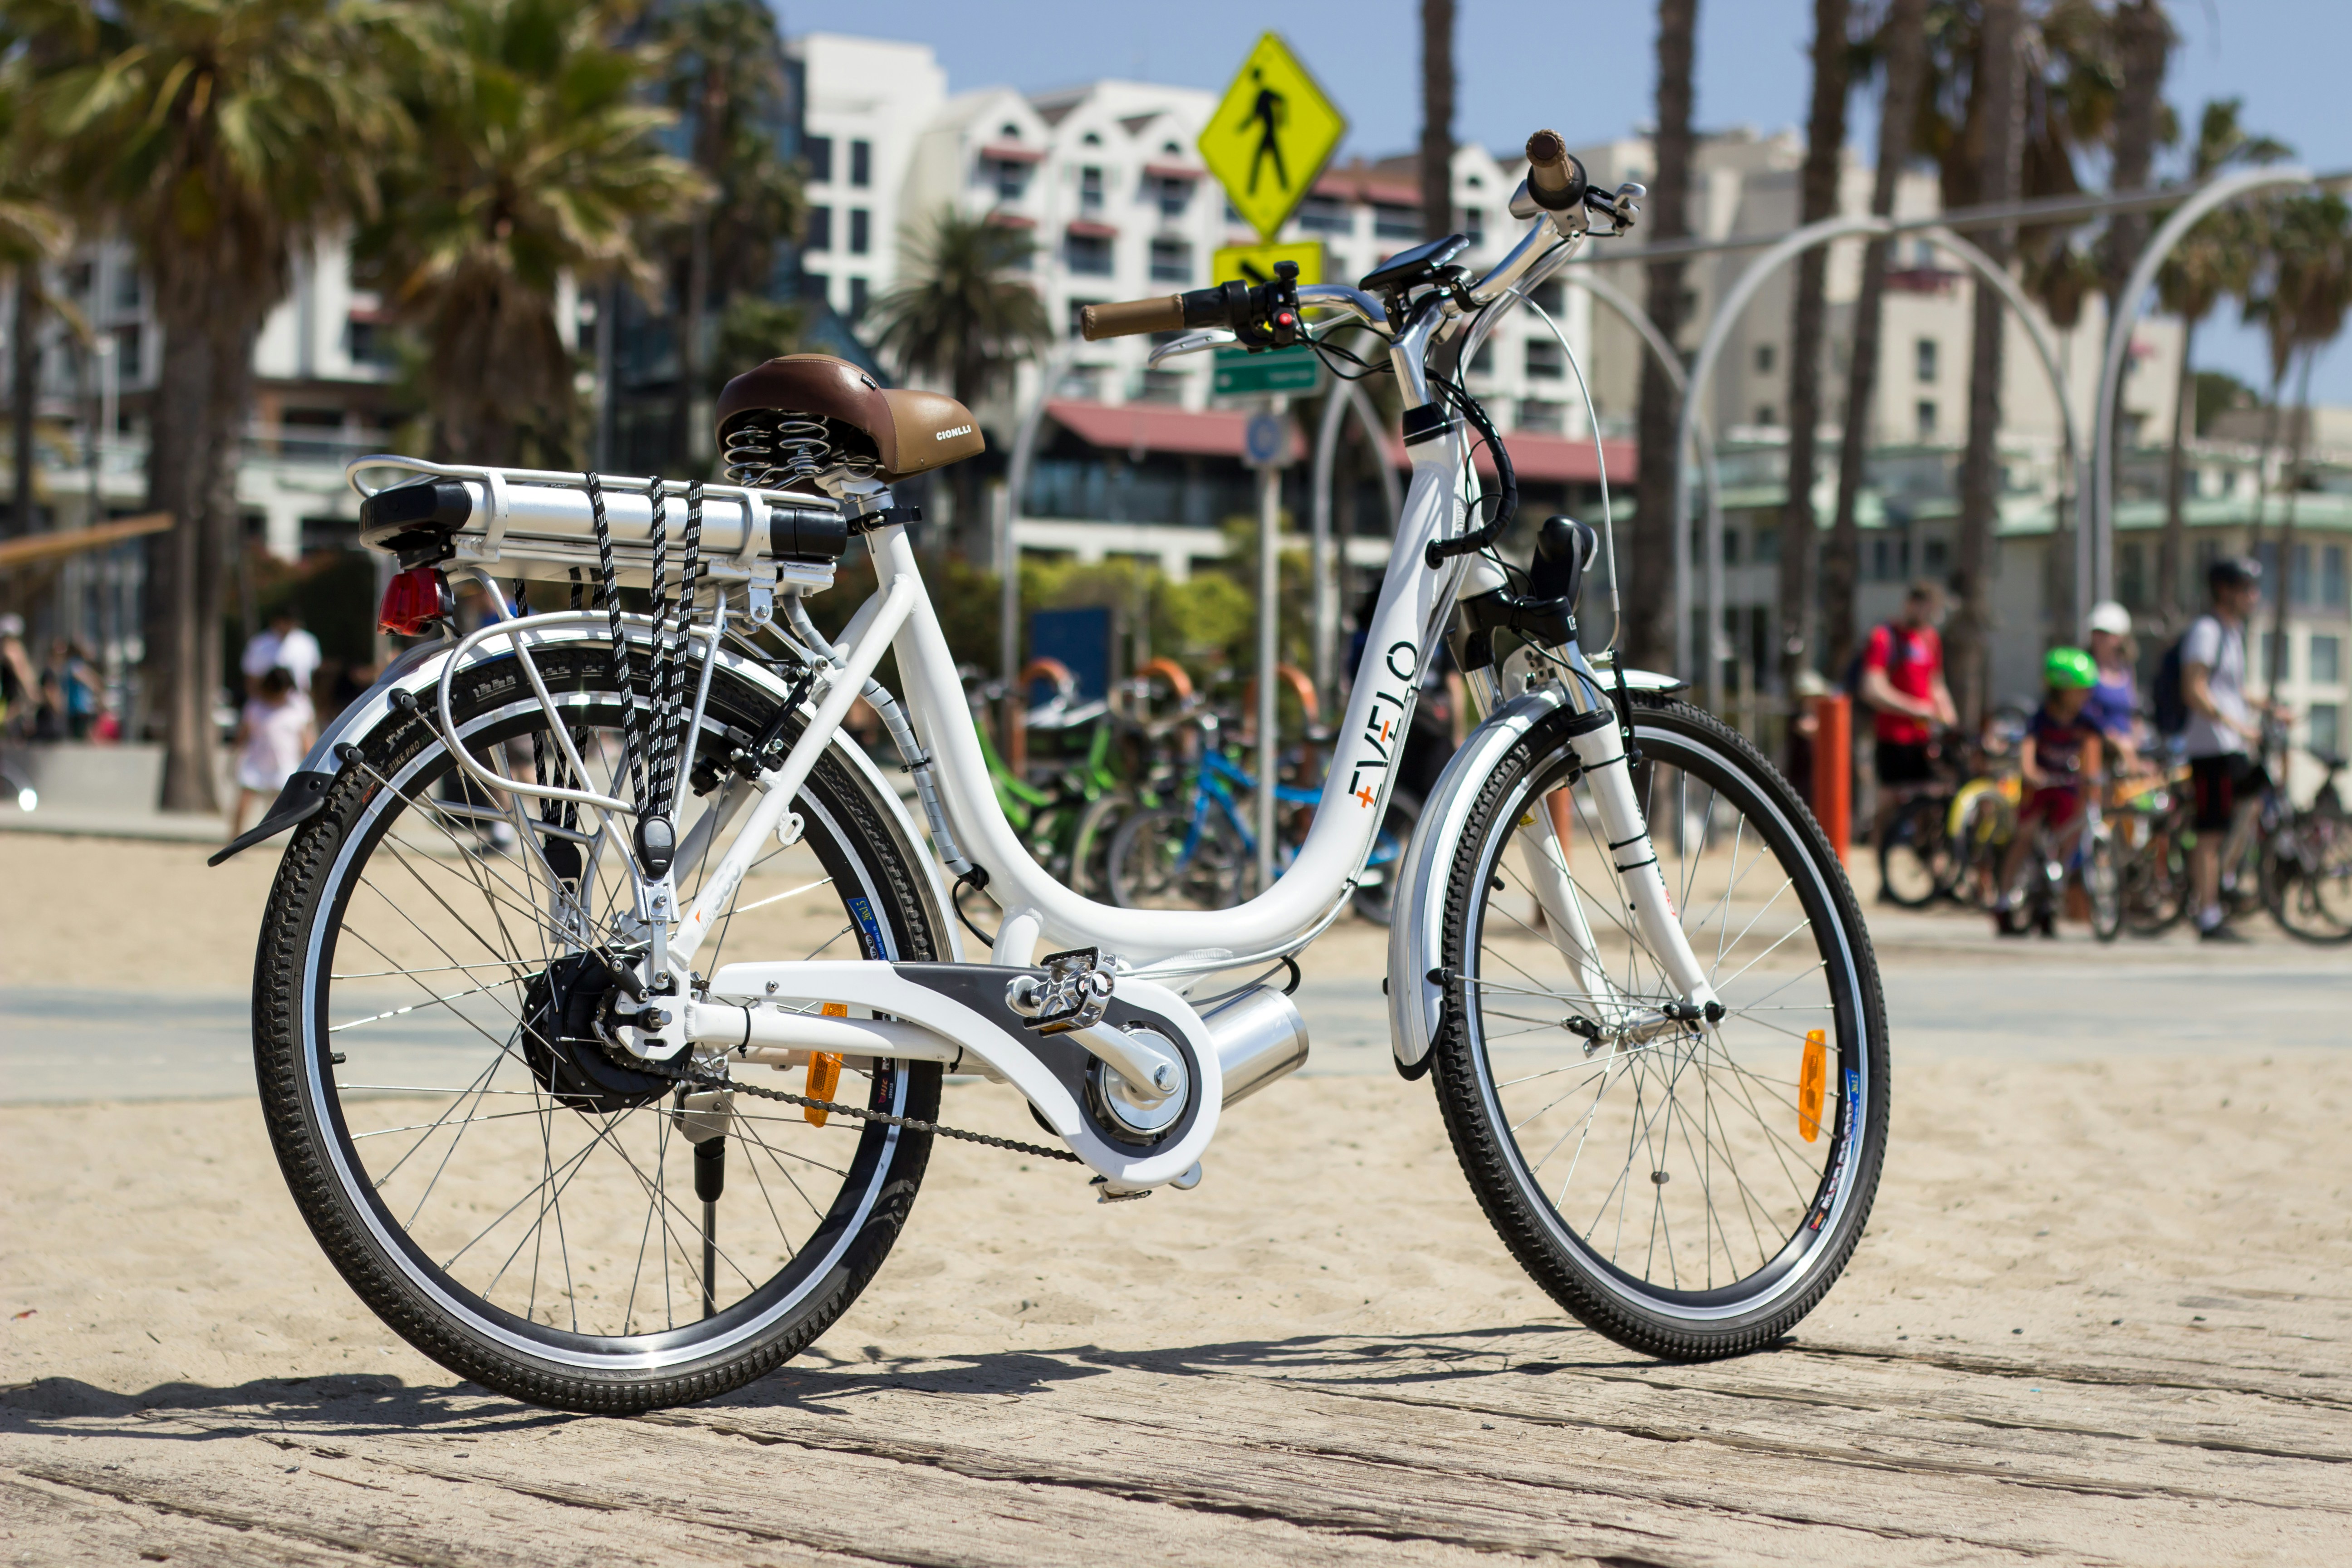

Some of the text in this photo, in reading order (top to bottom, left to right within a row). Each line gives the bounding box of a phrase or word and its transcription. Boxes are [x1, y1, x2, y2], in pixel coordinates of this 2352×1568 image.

[936, 425, 972, 441] CIONLLI
[1348, 641, 1418, 809] EVELO
[380, 752, 405, 779] e-BIKE
[405, 740, 420, 757] PRO
